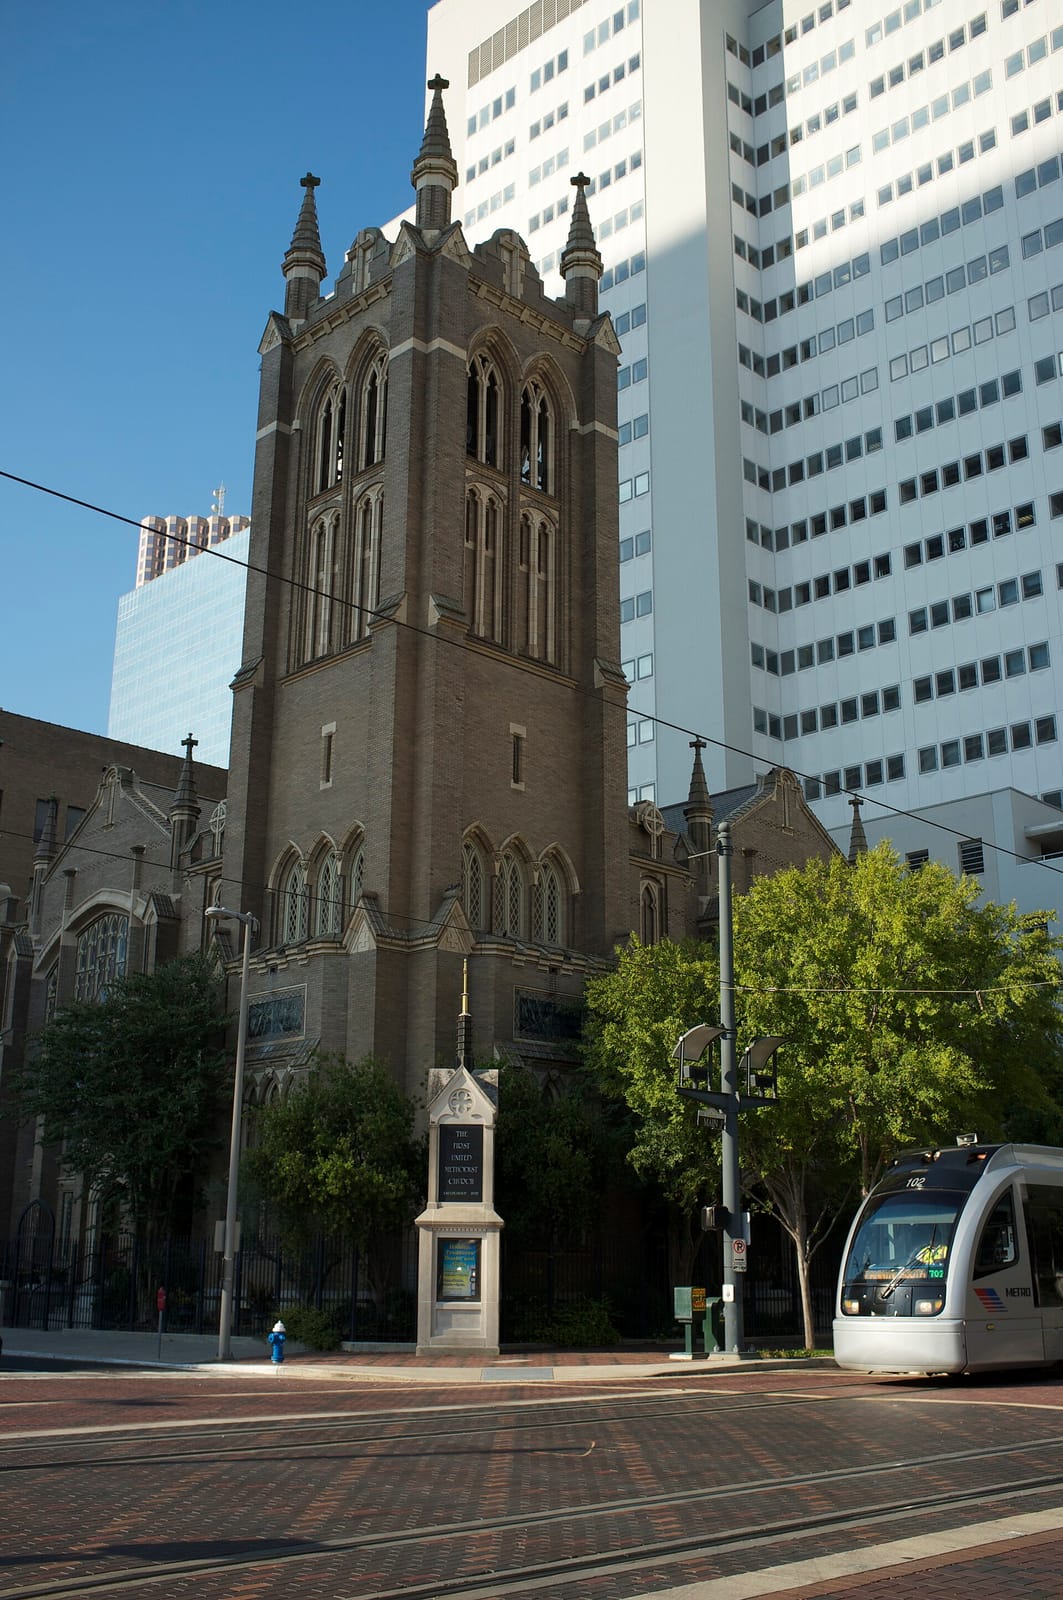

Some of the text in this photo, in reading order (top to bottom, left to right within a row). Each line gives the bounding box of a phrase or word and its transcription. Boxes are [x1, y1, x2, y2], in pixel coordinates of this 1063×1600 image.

[455, 1130, 468, 1138] THE
[453, 1142, 471, 1150] FIRST
[444, 1166, 478, 1174] METHODIST
[447, 1177, 474, 1185] CHURCH
[905, 1177, 926, 1188] 102
[1005, 1287, 1031, 1297] METRO
